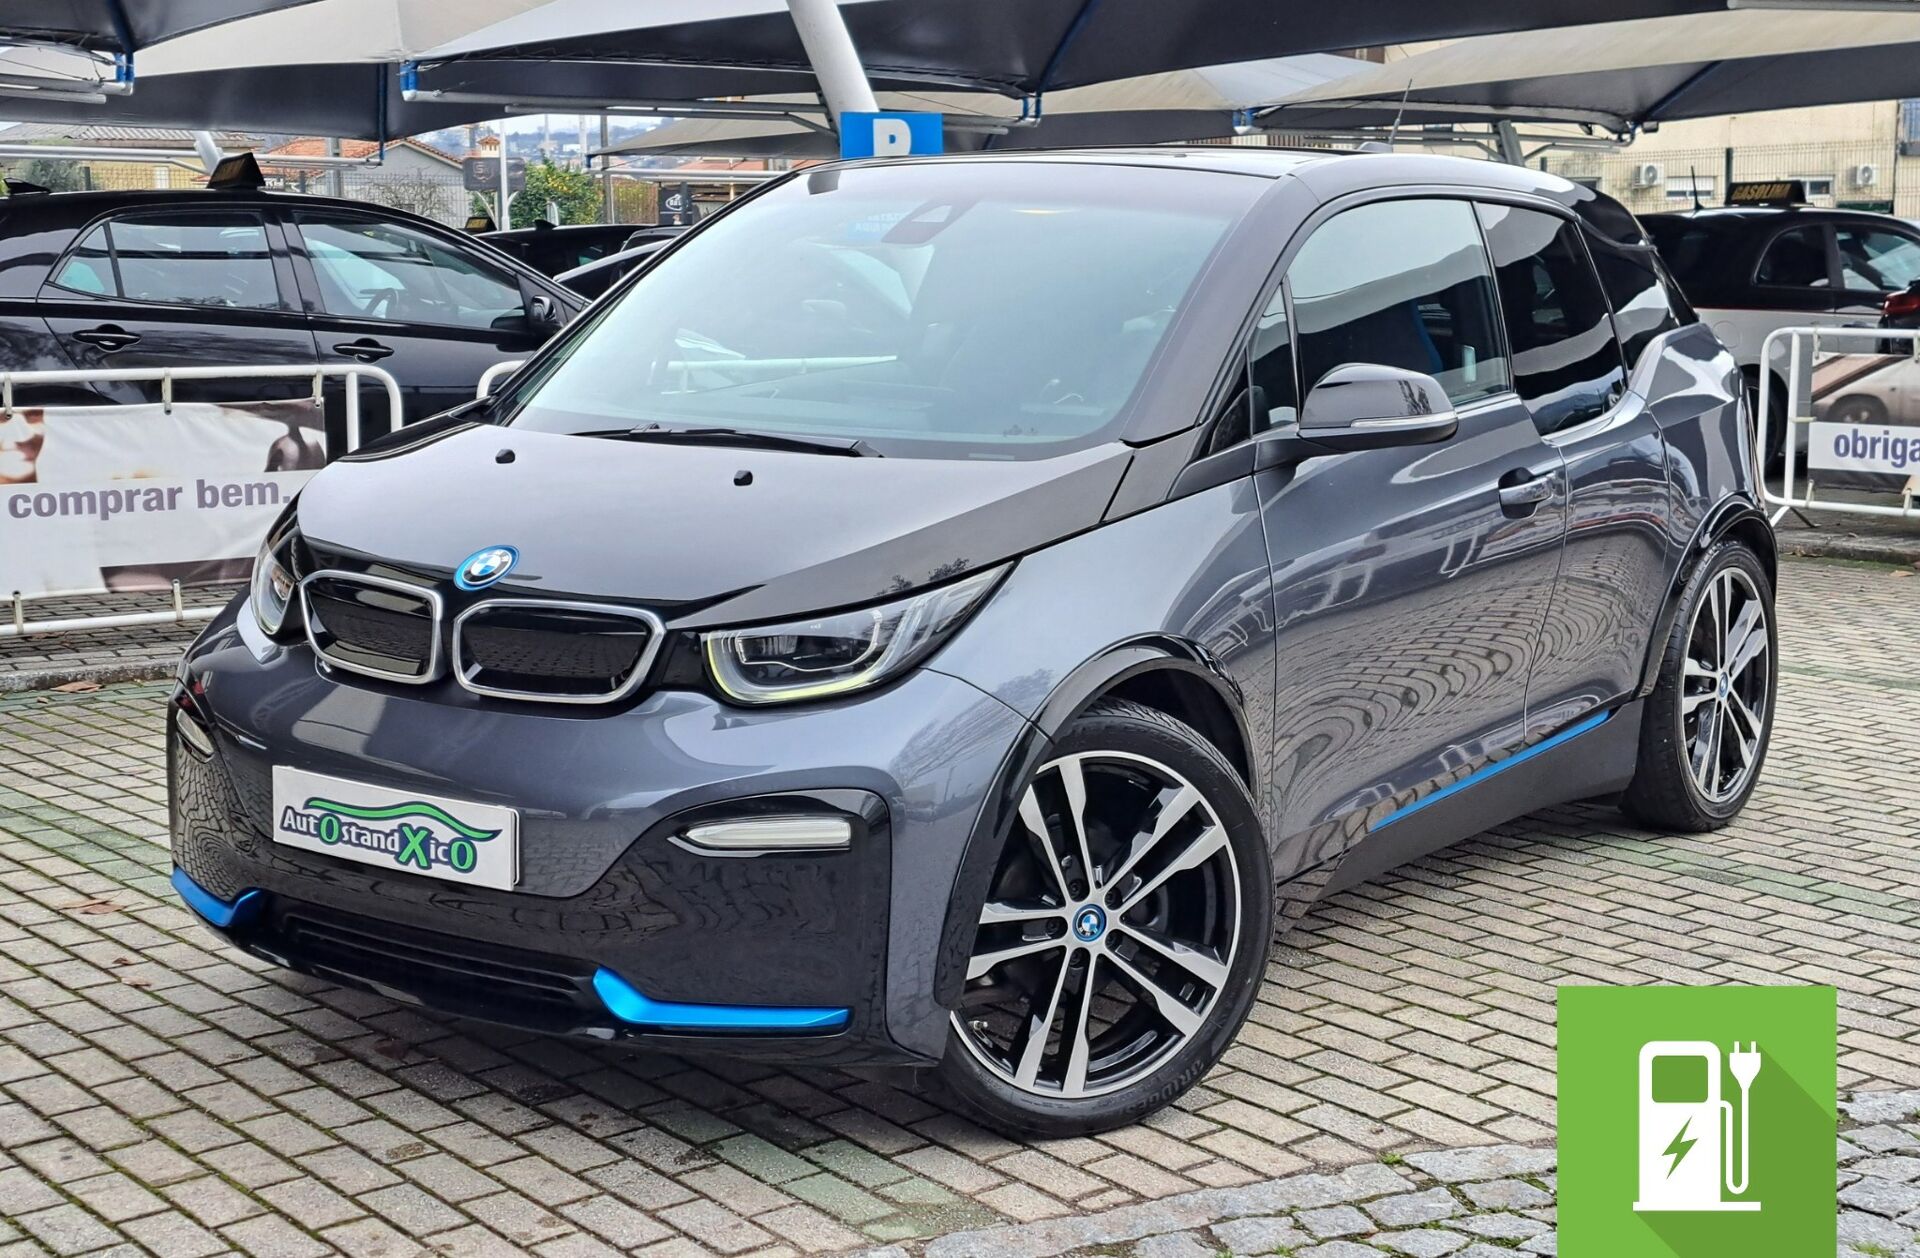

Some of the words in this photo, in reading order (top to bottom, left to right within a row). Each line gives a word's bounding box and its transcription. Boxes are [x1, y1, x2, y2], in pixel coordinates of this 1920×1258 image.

[1731, 183, 1792, 201] GASOLINA
[1834, 428, 1920, 469] obriga
[8, 485, 183, 521] comprar
[196, 479, 291, 509] bem.
